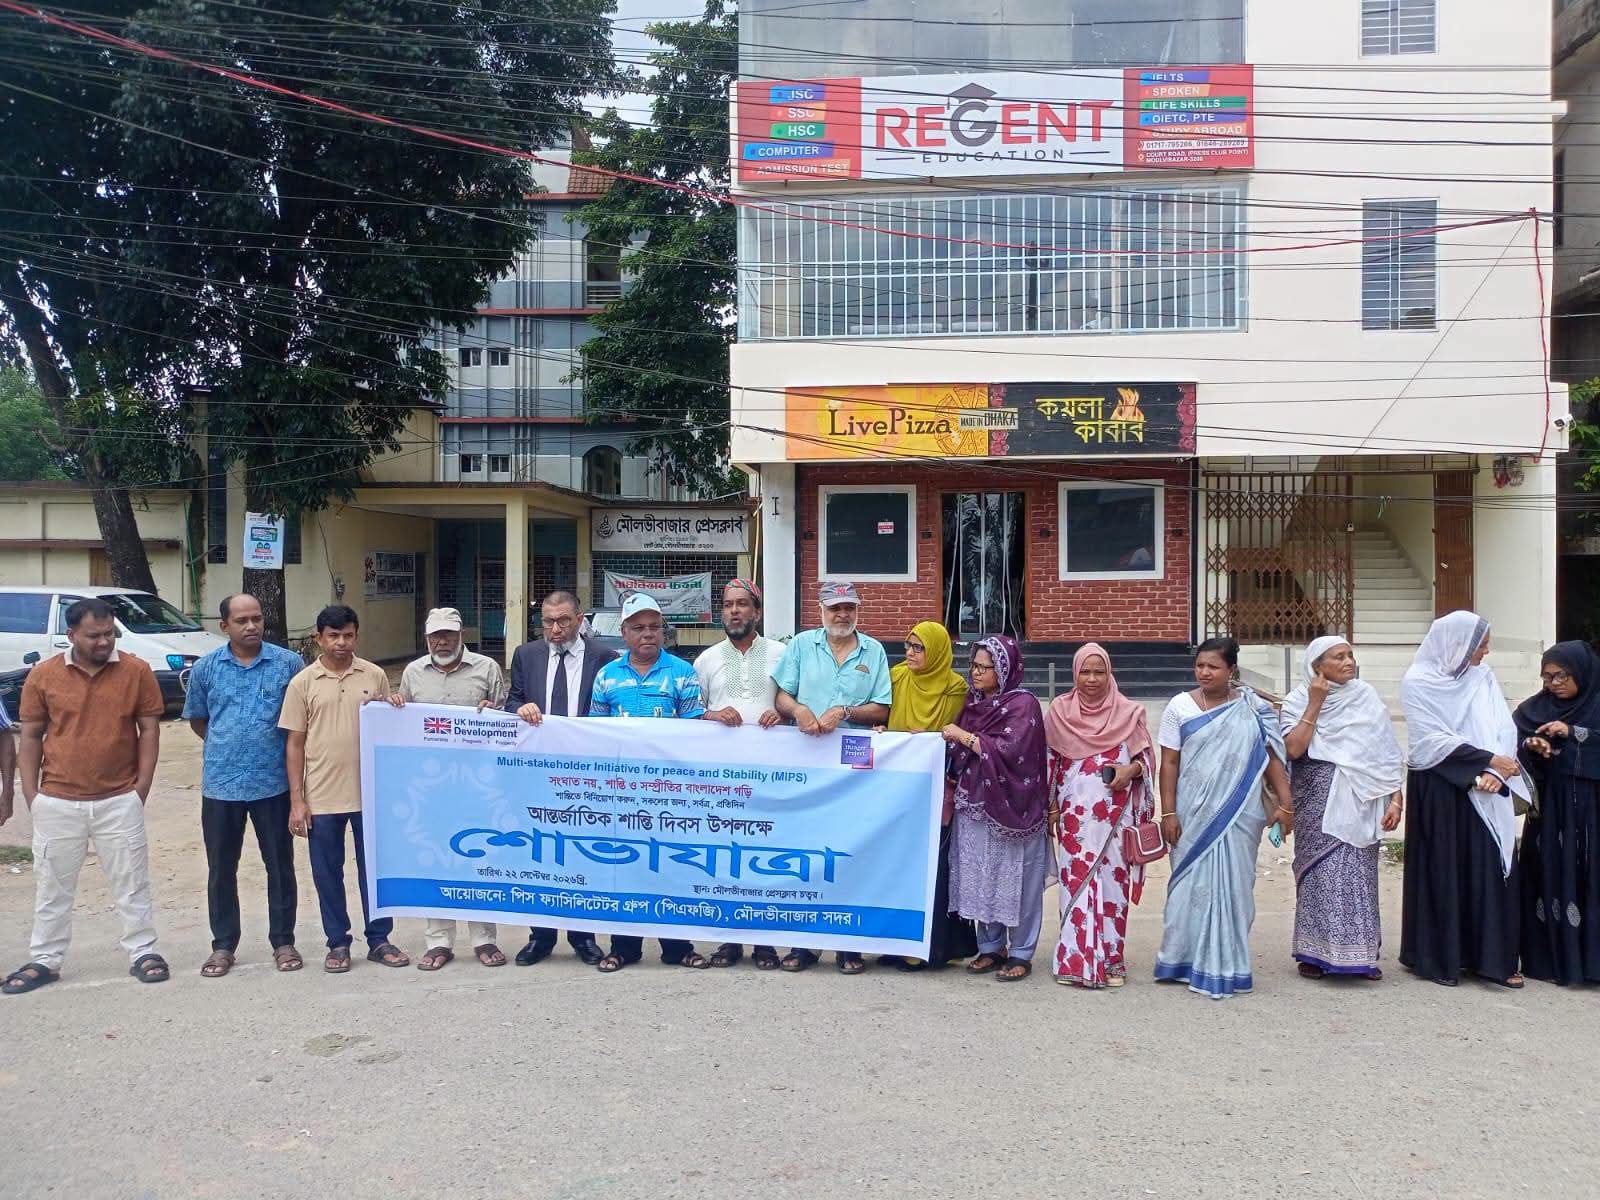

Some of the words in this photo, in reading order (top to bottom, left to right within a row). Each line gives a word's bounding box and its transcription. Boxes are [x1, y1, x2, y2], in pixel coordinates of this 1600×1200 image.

[1152, 73, 1184, 82] IELTS
[1152, 87, 1200, 97] SPOKEN
[1152, 100, 1177, 110] LIFE
[1180, 99, 1221, 109] SKILLS
[788, 107, 815, 118] SSC
[1152, 114, 1190, 123] OIETC,
[1193, 113, 1215, 122] PTE
[875, 100, 1114, 148] REGENT
[788, 125, 816, 137] HSC
[1192, 126, 1243, 136] ABROAD
[758, 147, 819, 157] COMPUTER
[922, 148, 1064, 163] EDUCATION
[756, 164, 817, 175] ADMISSION
[821, 163, 849, 173] TEST
[1035, 397, 1105, 421] কয়লা
[828, 407, 952, 436] LivePizza
[961, 417, 976, 427] MADE
[976, 417, 983, 427] IN
[984, 412, 1016, 426] DHAKA
[1072, 420, 1146, 444] কাবাব
[616, 513, 691, 534] মৌলভীবাজার
[695, 515, 744, 534] প্রেসক্লাব
[454, 718, 466, 726] UK
[468, 719, 518, 729] International
[454, 726, 518, 738] Development
[497, 756, 591, 771] Multi-stakeholder
[594, 761, 640, 774] Initiative
[643, 764, 659, 775] for
[662, 767, 696, 779] peace
[698, 768, 719, 779] and
[722, 768, 768, 783] Stability
[770, 771, 807, 784] (MIPS)
[549, 776, 580, 787] সংঘাত
[605, 777, 626, 790] শান্তি
[629, 781, 637, 790] ও
[685, 783, 732, 796] বাংলাদেশ
[734, 784, 753, 798] গড়ি
[527, 806, 612, 827] আন্তর্জাতিক
[618, 809, 654, 831] শান্তি
[658, 811, 702, 834] দিবস
[707, 812, 775, 836] উপলক্ষে
[449, 827, 853, 883] শোভাযাত্রা
[505, 870, 518, 879] ২২
[712, 884, 763, 897] মৌলভীবাজার
[510, 887, 535, 905] পিস
[539, 890, 620, 913] ফ্যাসিলিটেটর
[622, 899, 650, 914] গ্রুপ
[733, 904, 819, 925] মৌলভীবাজার
